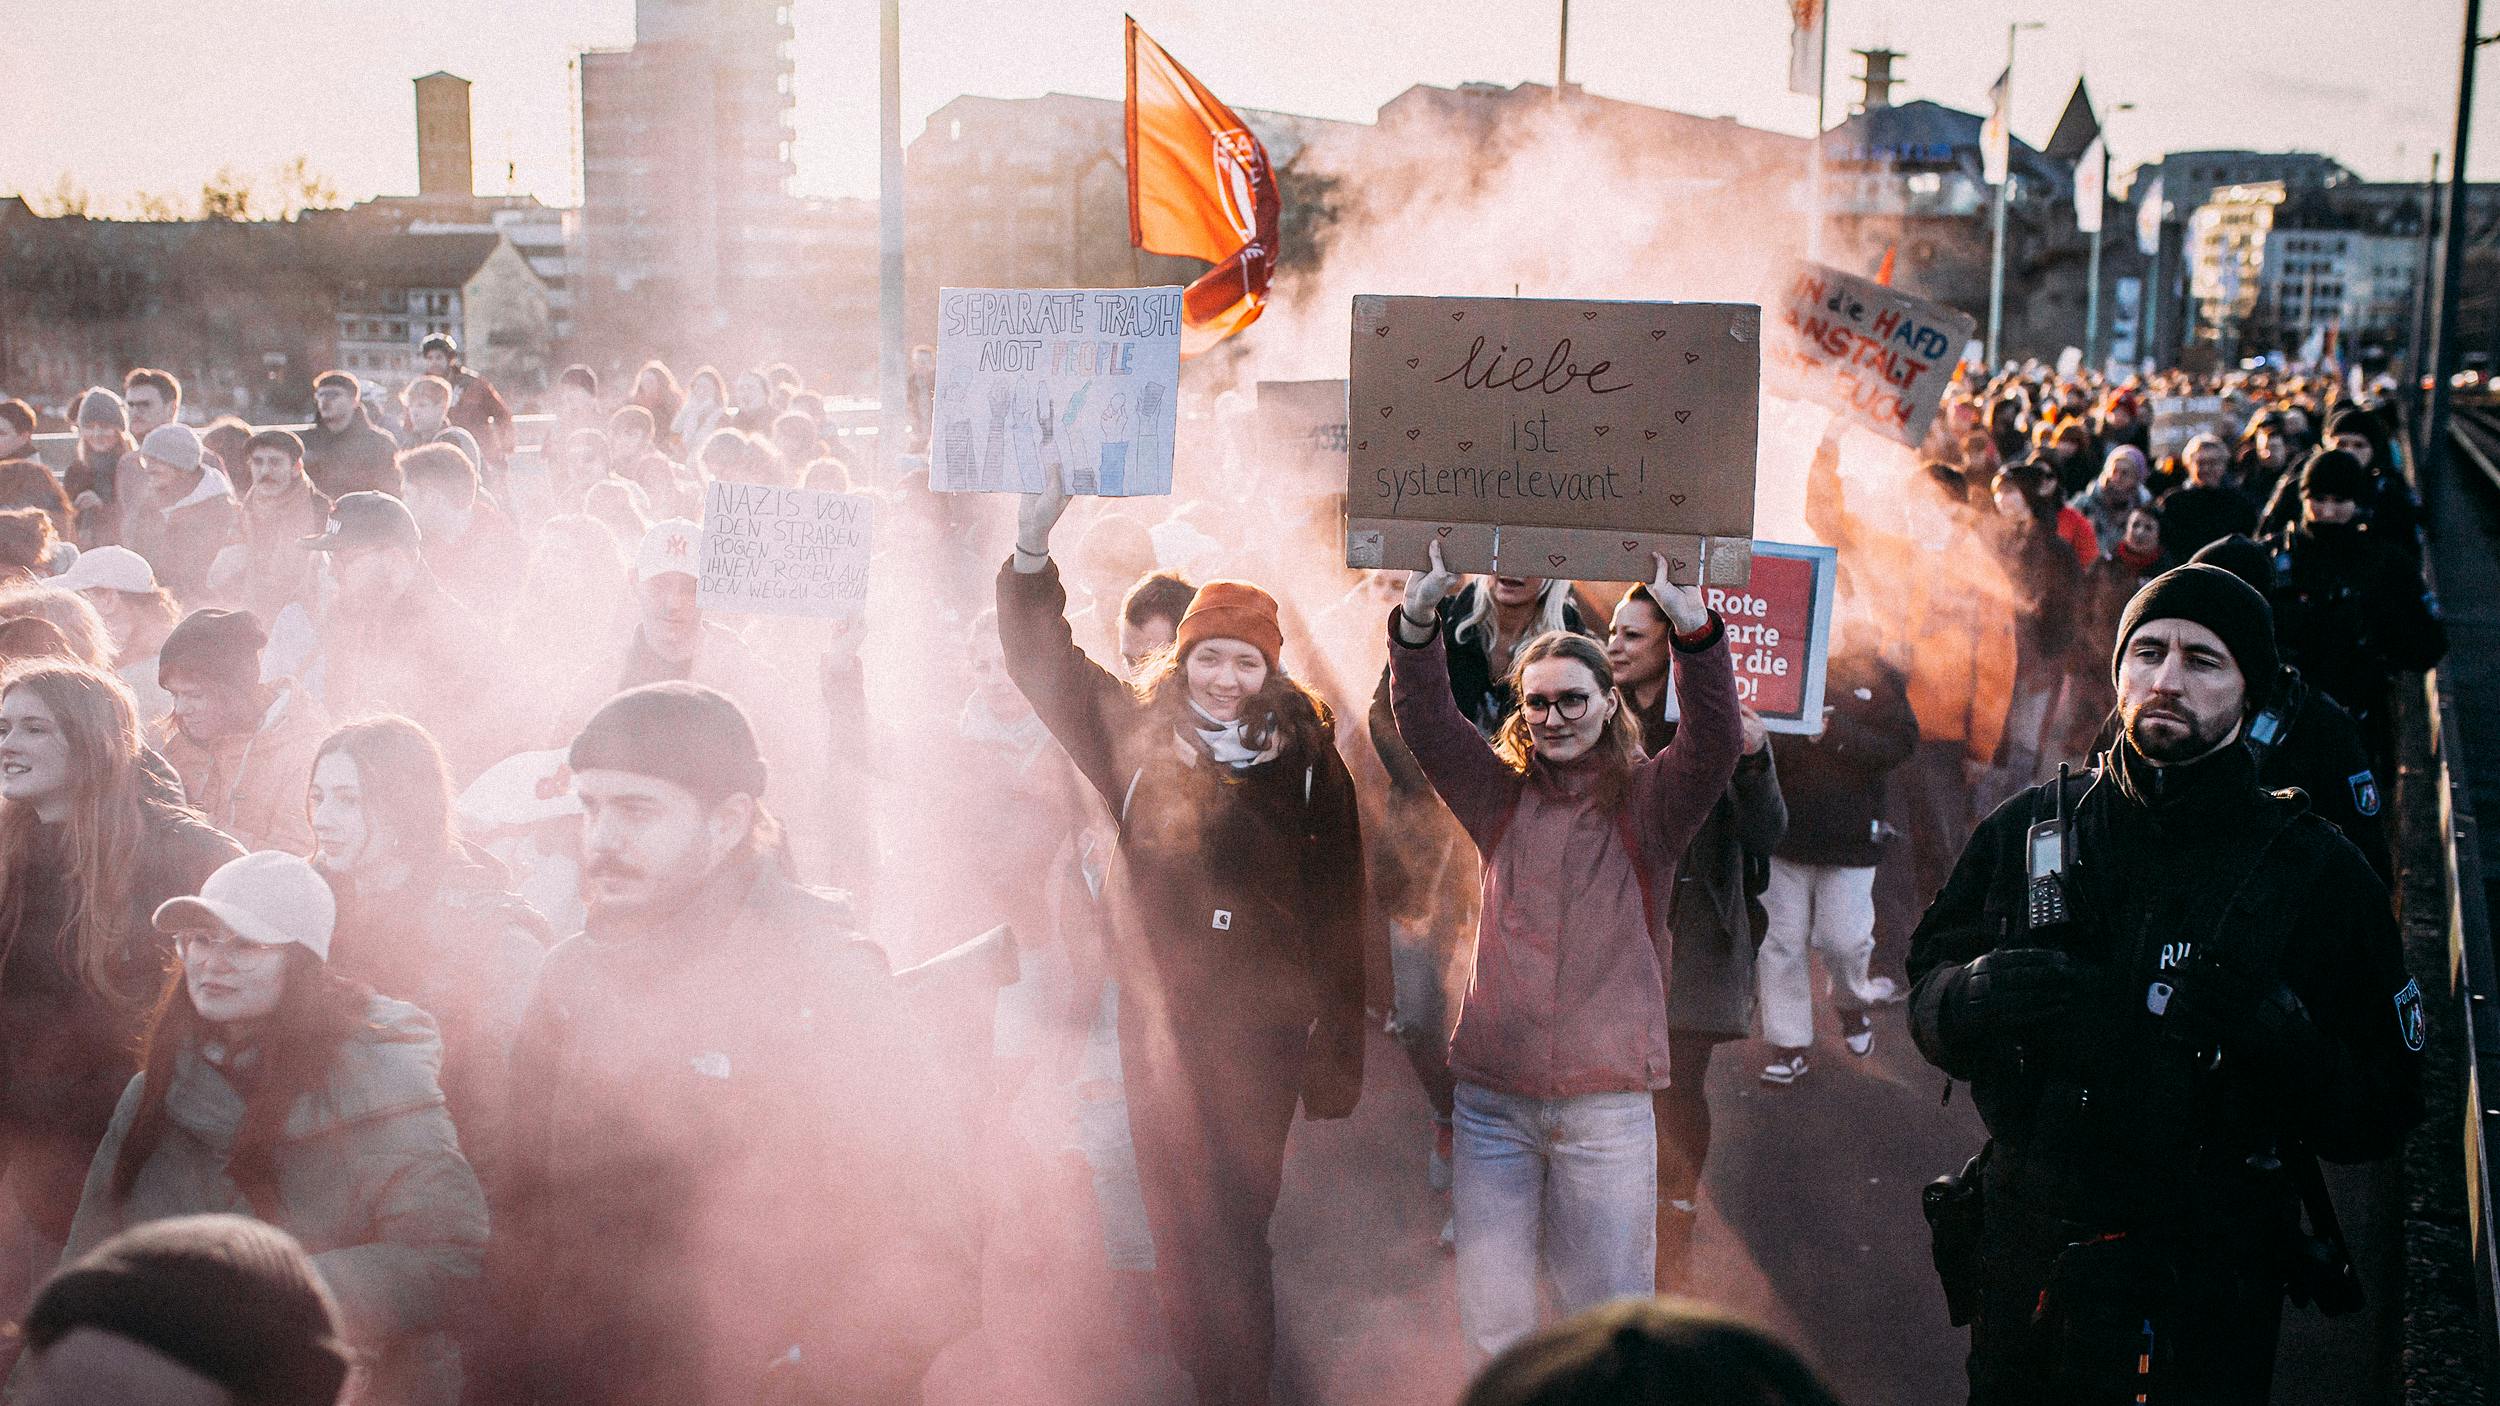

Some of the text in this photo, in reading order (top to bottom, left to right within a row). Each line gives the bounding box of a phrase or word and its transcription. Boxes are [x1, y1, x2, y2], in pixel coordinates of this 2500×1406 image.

[945, 293, 1181, 337] SEPARATE TRASH
[1872, 307, 1949, 360] HAFD
[979, 340, 1136, 377] NOT PEOPLE
[1434, 336, 1634, 394] liebe
[1511, 408, 1559, 453] ist
[717, 483, 858, 524] NAZIS VON
[1376, 461, 1623, 514] systemrelevant
[714, 514, 761, 537] DEN
[707, 557, 762, 579] IHNEN
[784, 544, 840, 562] STATT
[701, 575, 741, 595] DEN
[1707, 588, 1768, 617] Rote
[1722, 619, 1780, 647] arte
[1746, 649, 1788, 676] die
